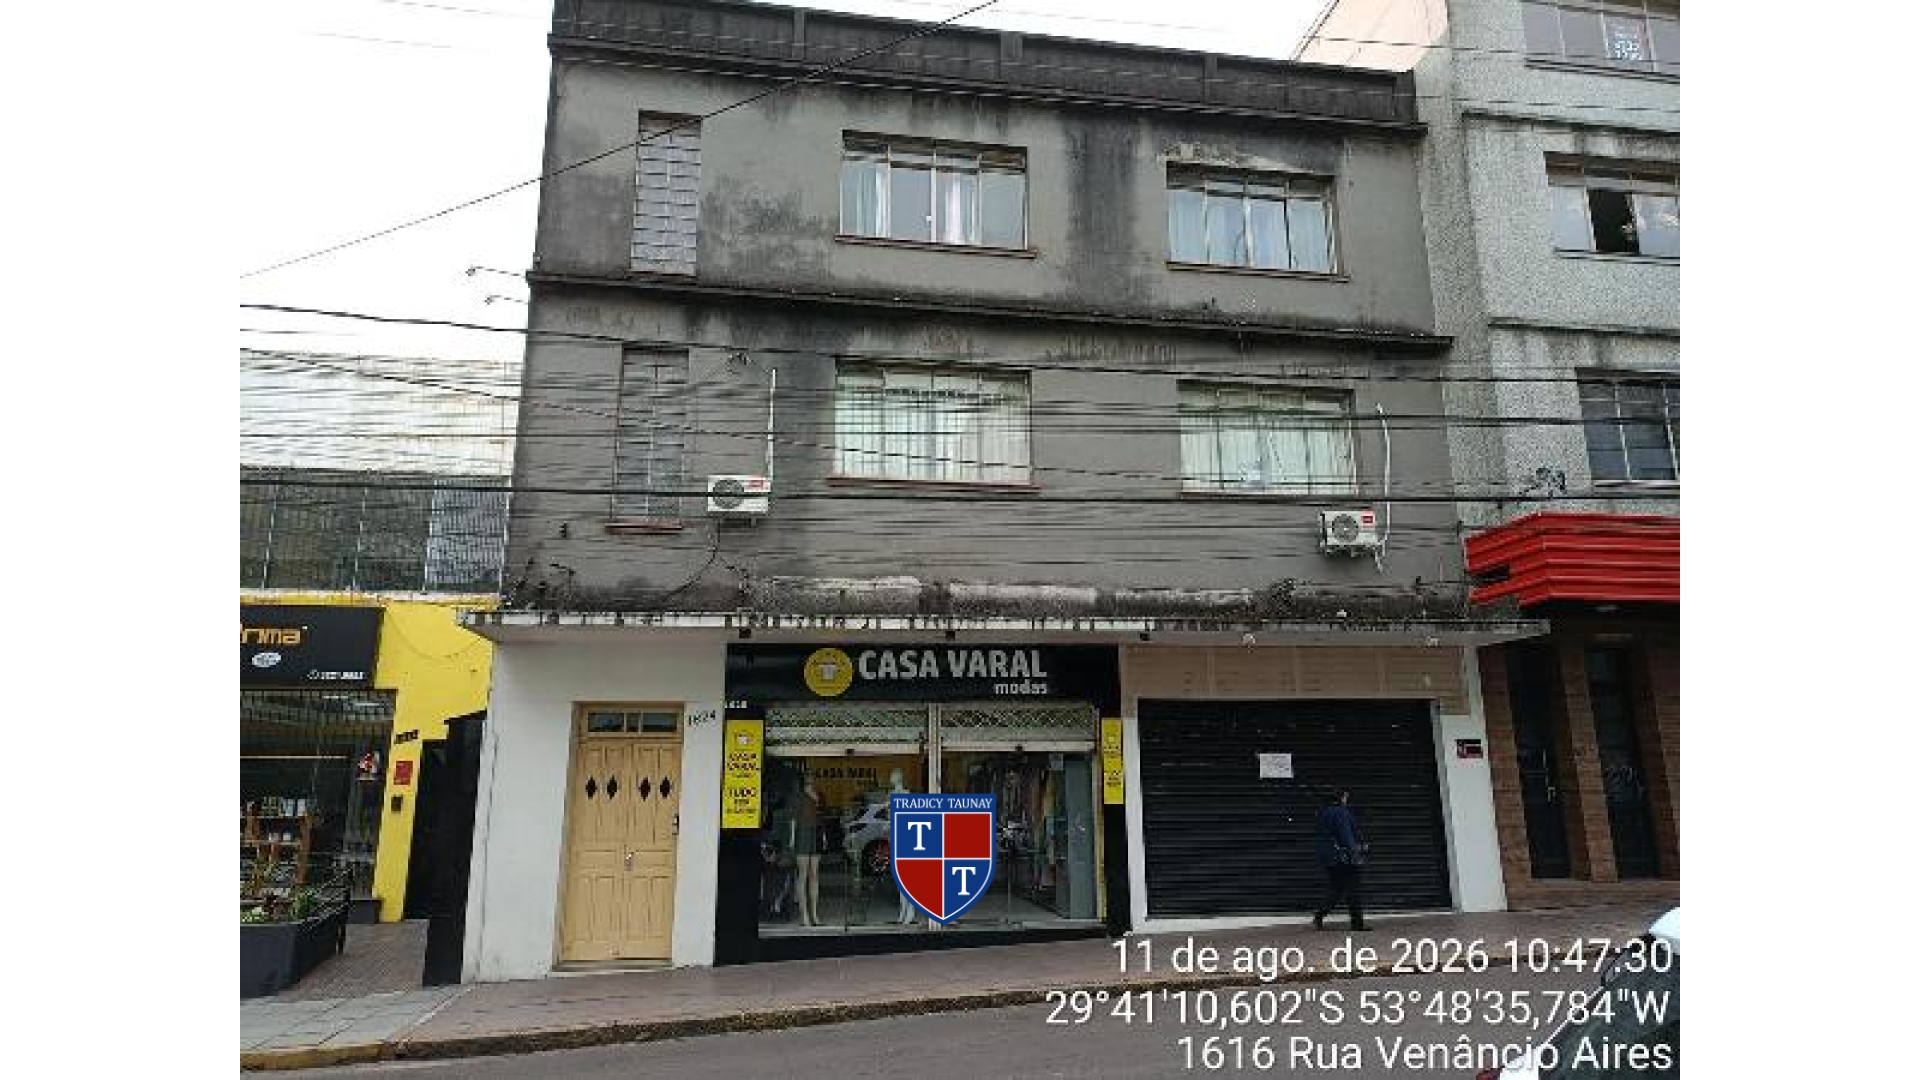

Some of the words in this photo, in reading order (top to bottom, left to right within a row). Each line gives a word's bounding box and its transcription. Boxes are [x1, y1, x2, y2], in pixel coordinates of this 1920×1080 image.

[858, 650, 939, 680] CASA
[947, 650, 1048, 678] VARAL
[995, 679, 1048, 694] modas
